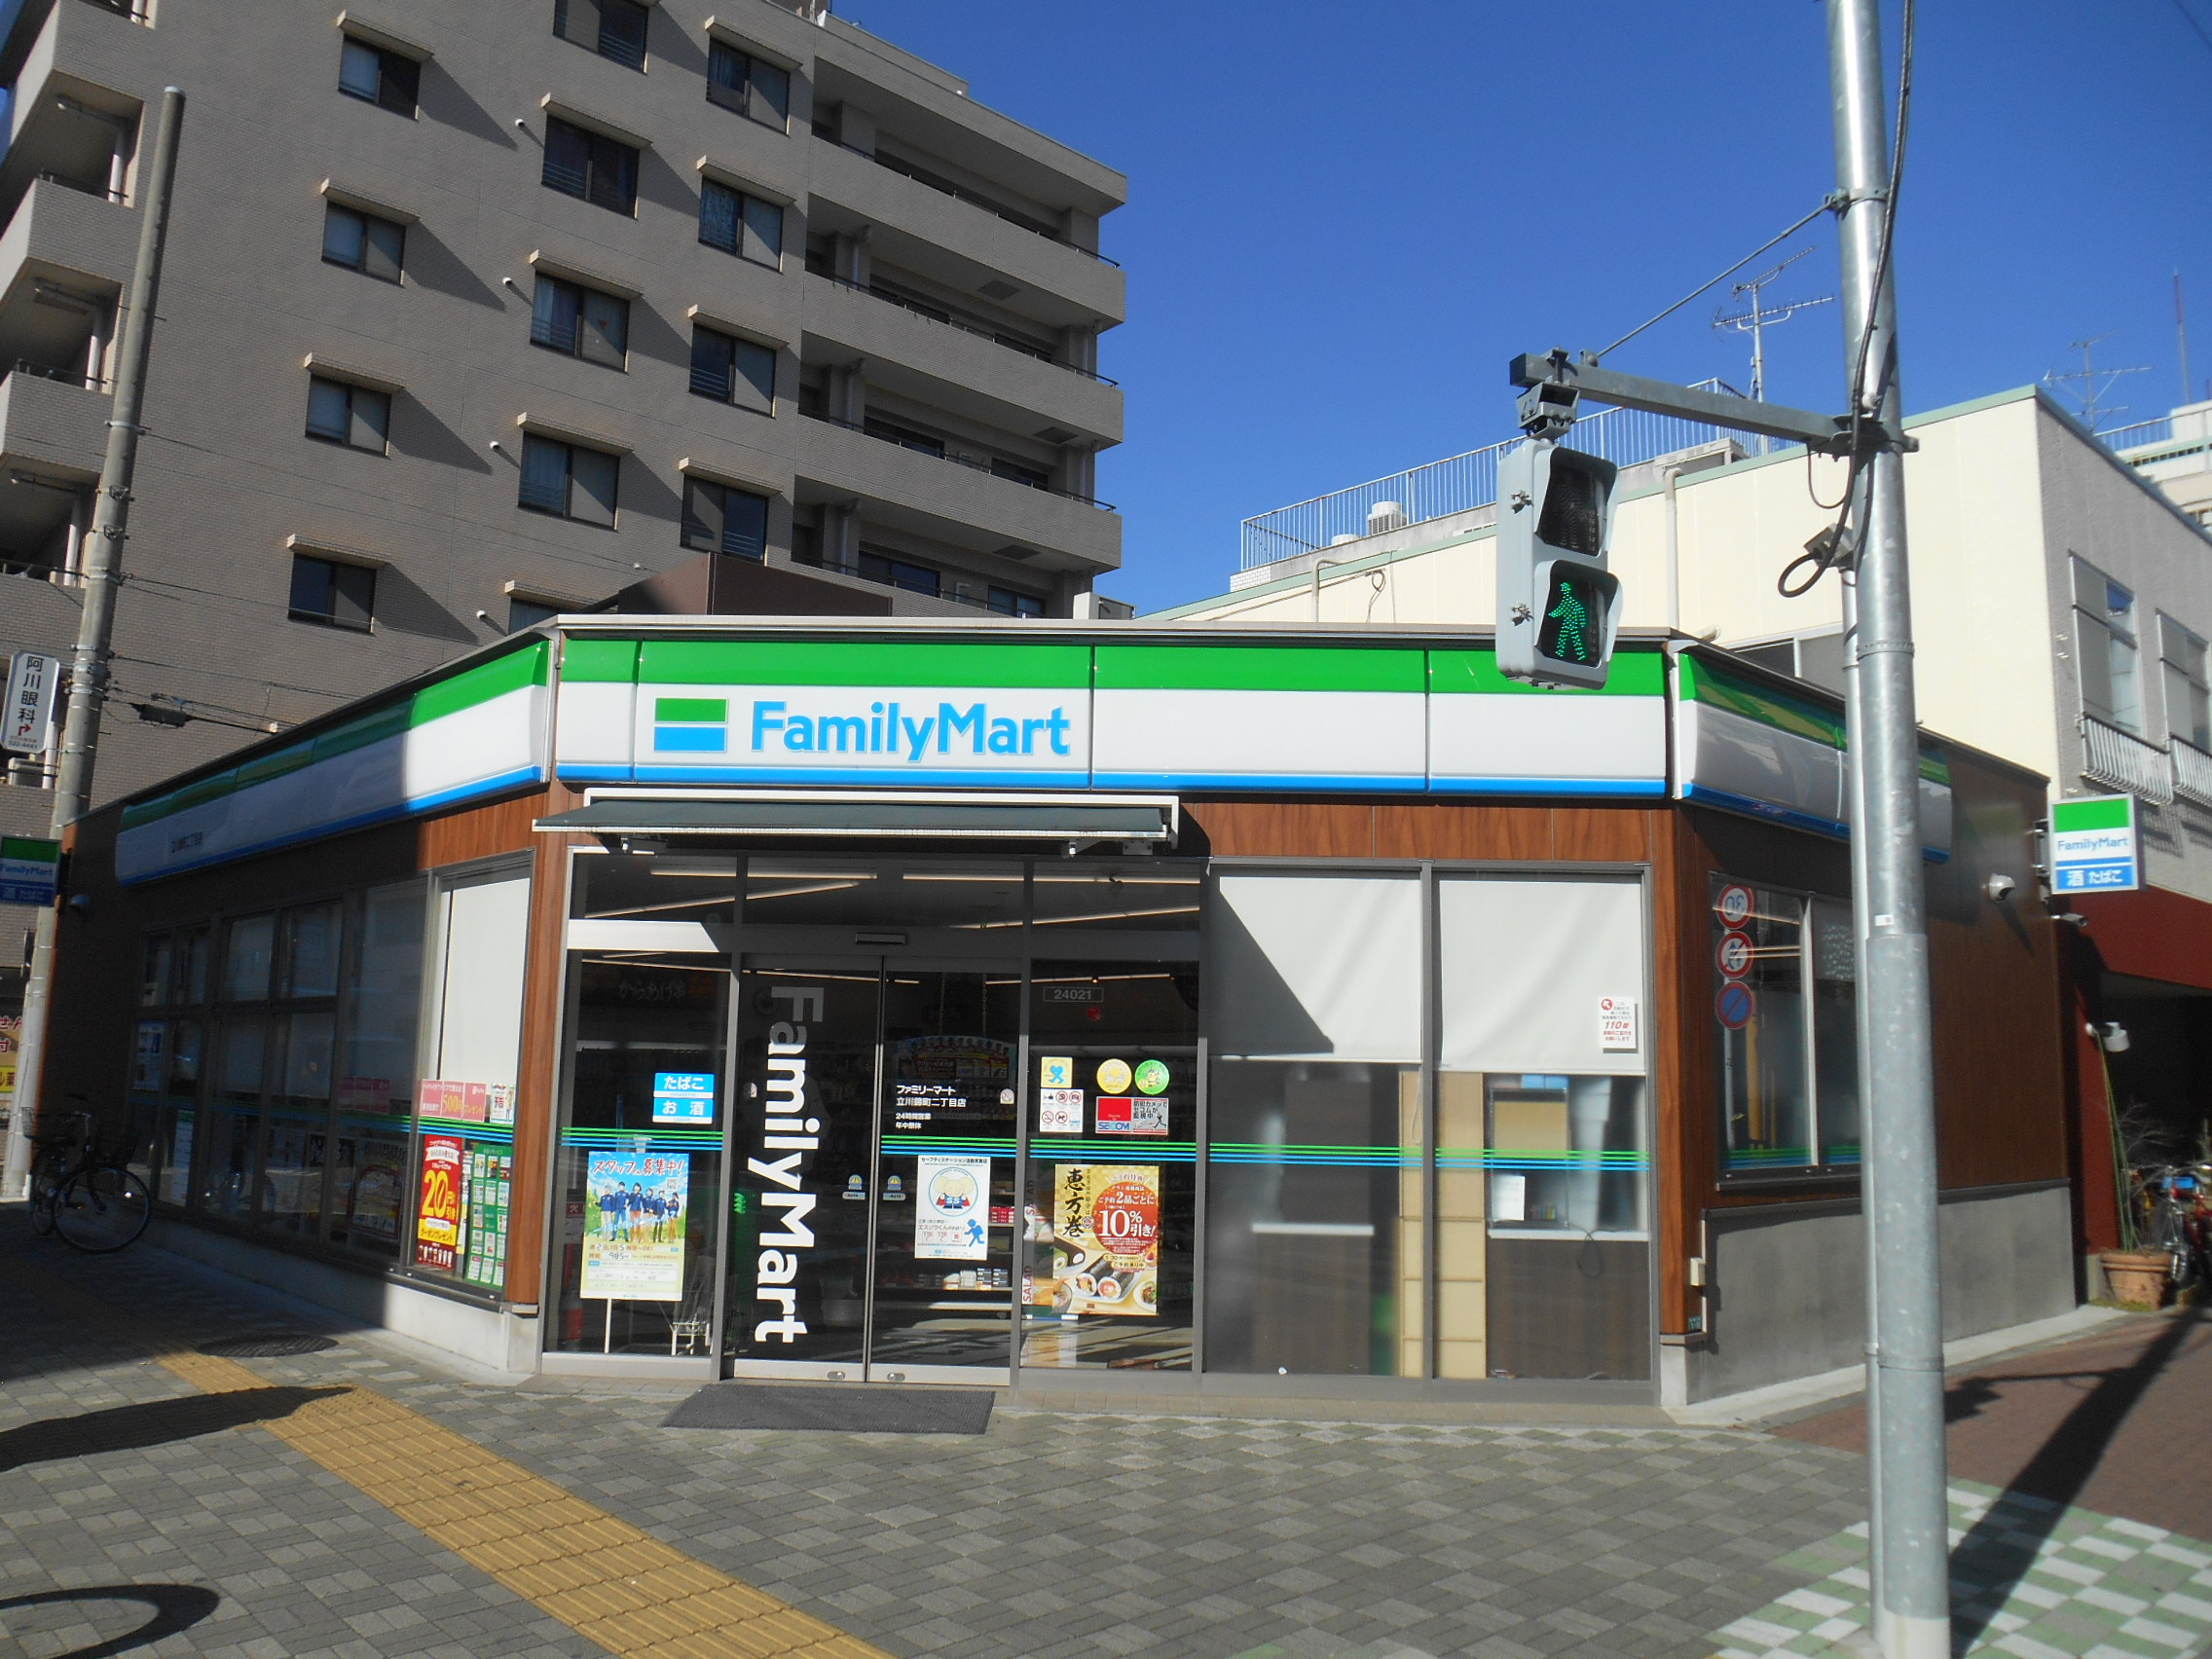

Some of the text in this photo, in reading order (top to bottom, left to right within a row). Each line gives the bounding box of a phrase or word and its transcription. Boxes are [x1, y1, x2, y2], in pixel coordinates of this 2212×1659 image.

[18, 655, 45, 724] 阿川眼科
[751, 699, 1071, 763] FamilyMart
[2057, 836, 2129, 852] FamilyMart
[2067, 868, 2123, 887] 酒 たばこ
[1052, 988, 1092, 1001] 24021
[663, 1075, 706, 1090] たばこ
[896, 1085, 956, 1096] ファミリーマート
[1097, 1122, 1130, 1131] SECOM
[747, 984, 826, 1345] FamilyMart
[422, 1169, 449, 1219] 20
[1062, 1167, 1087, 1237] 恵方巻
[1098, 1209, 1143, 1237] 10%
[1022, 1266, 1033, 1304] SALAD
